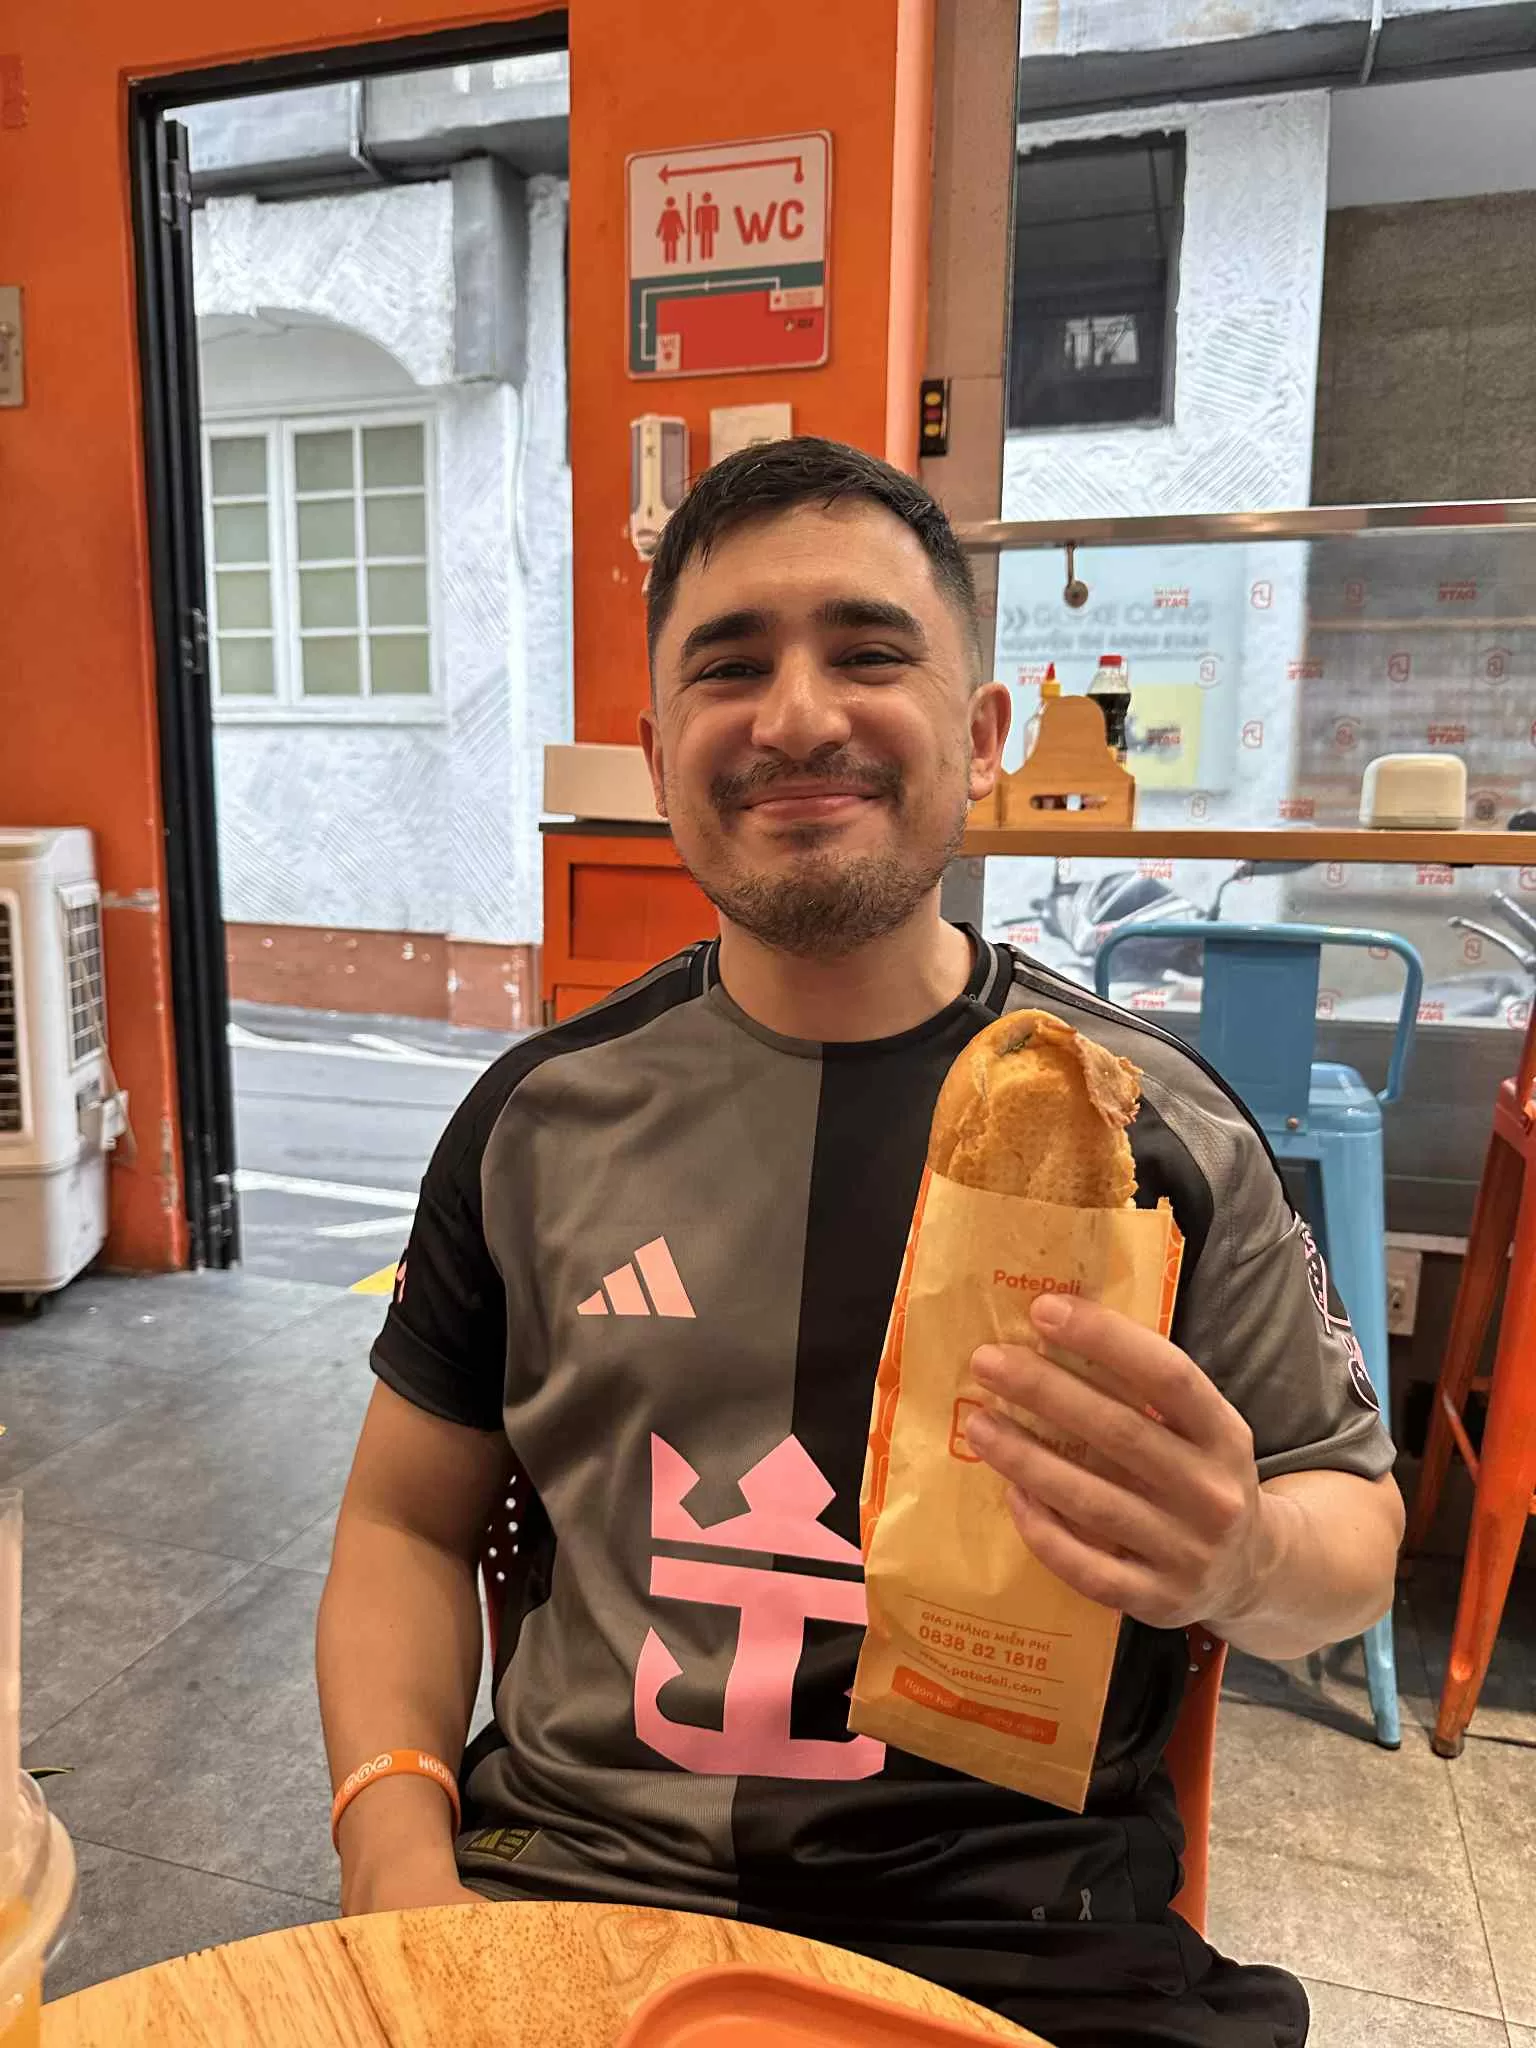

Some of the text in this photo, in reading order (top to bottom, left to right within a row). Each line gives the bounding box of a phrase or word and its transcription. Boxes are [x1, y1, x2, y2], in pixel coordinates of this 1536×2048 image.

[734, 200, 804, 246] WC
[993, 1269, 1081, 1295] PateDeli
[921, 1611, 952, 1627] GIAO
[955, 1618, 990, 1640] HÀNG
[919, 1625, 1048, 1672] 0838 82 1818
